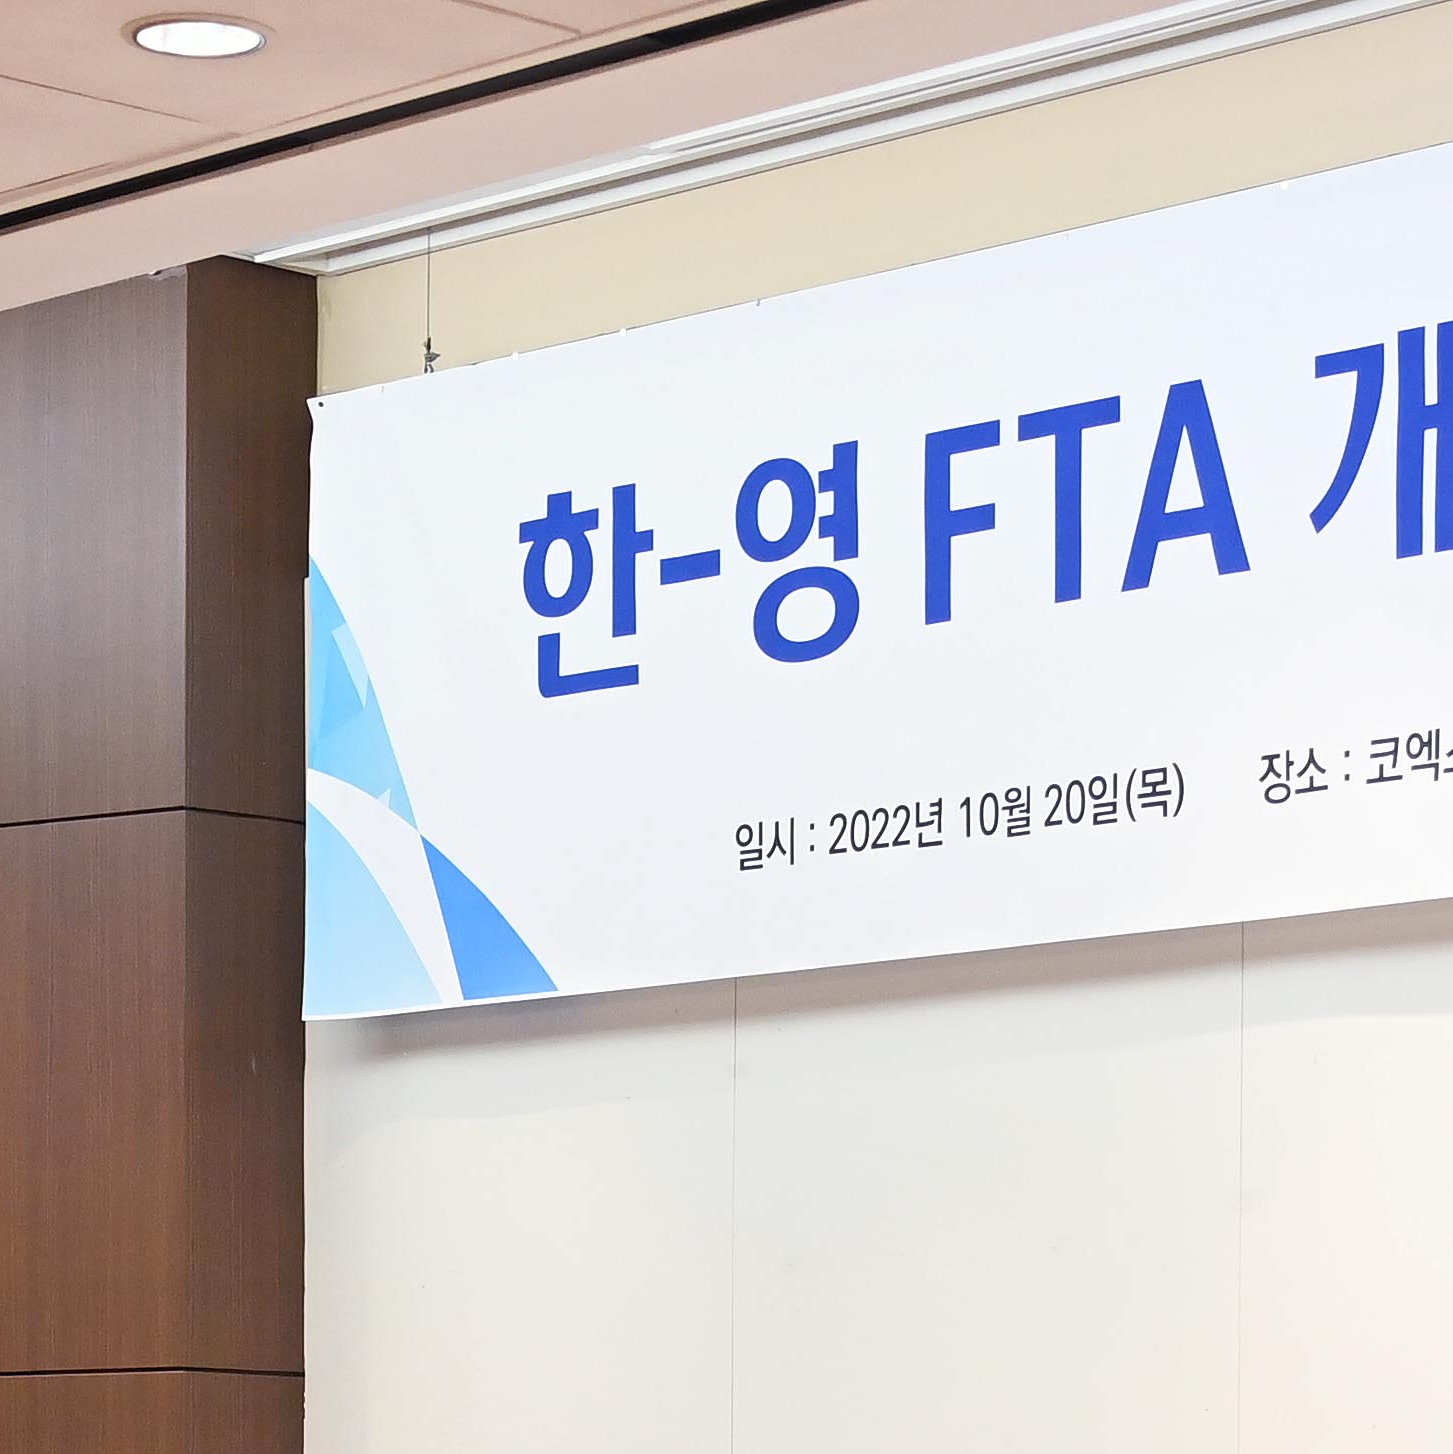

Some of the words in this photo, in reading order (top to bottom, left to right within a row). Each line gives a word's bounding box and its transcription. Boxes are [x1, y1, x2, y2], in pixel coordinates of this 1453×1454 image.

[518, 439, 860, 699] 한-영
[924, 378, 1251, 626] FTA
[735, 817, 795, 872] 일시
[828, 797, 943, 855] 2022년
[959, 785, 1031, 838] 10월
[1044, 762, 1185, 827] 20일(목)
[1258, 747, 1329, 804] 장소
